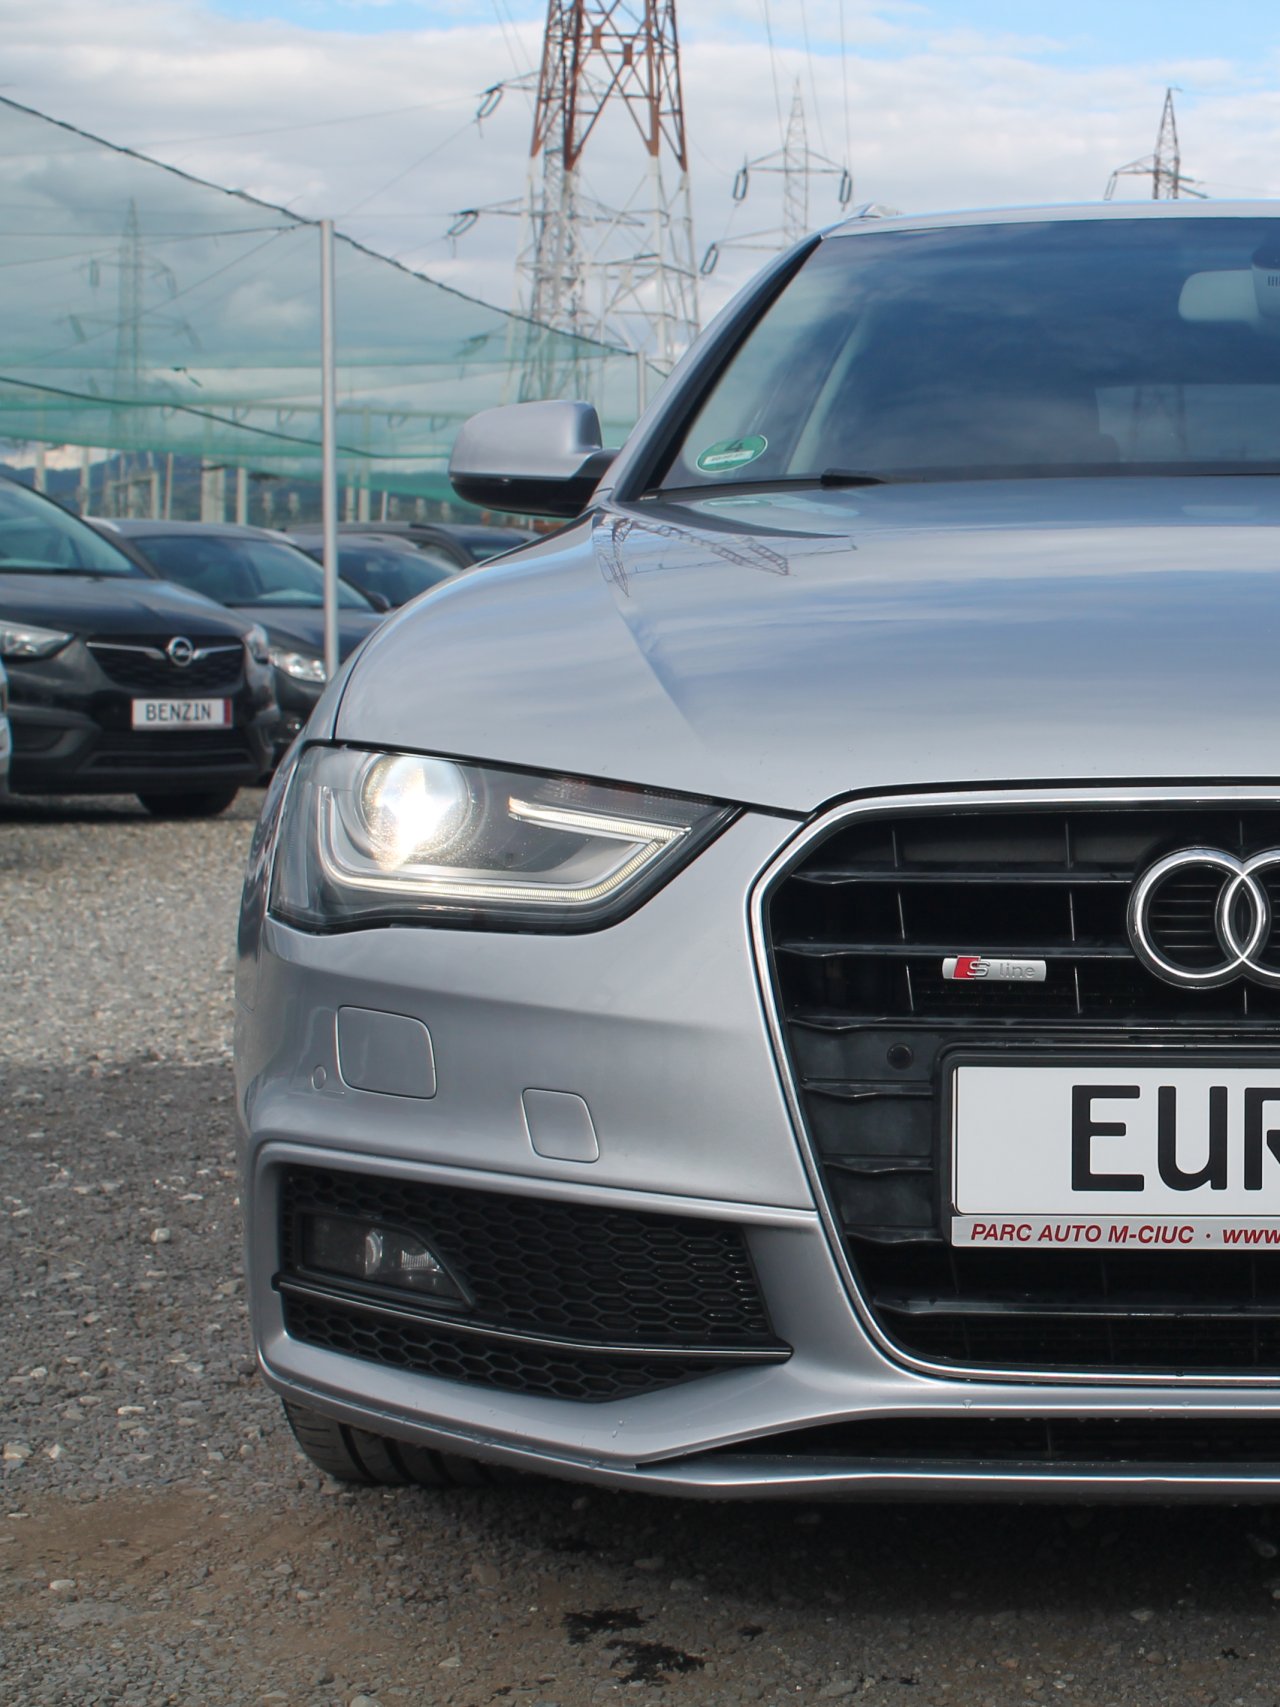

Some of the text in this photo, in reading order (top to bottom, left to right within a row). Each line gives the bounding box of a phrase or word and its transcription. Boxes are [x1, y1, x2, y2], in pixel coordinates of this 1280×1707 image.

[145, 702, 212, 721] BENZIN
[966, 960, 1036, 978] S line
[970, 1223, 1033, 1242] PARC
[1037, 1224, 1102, 1243] AUTO
[1107, 1224, 1195, 1244] M-CIUC
